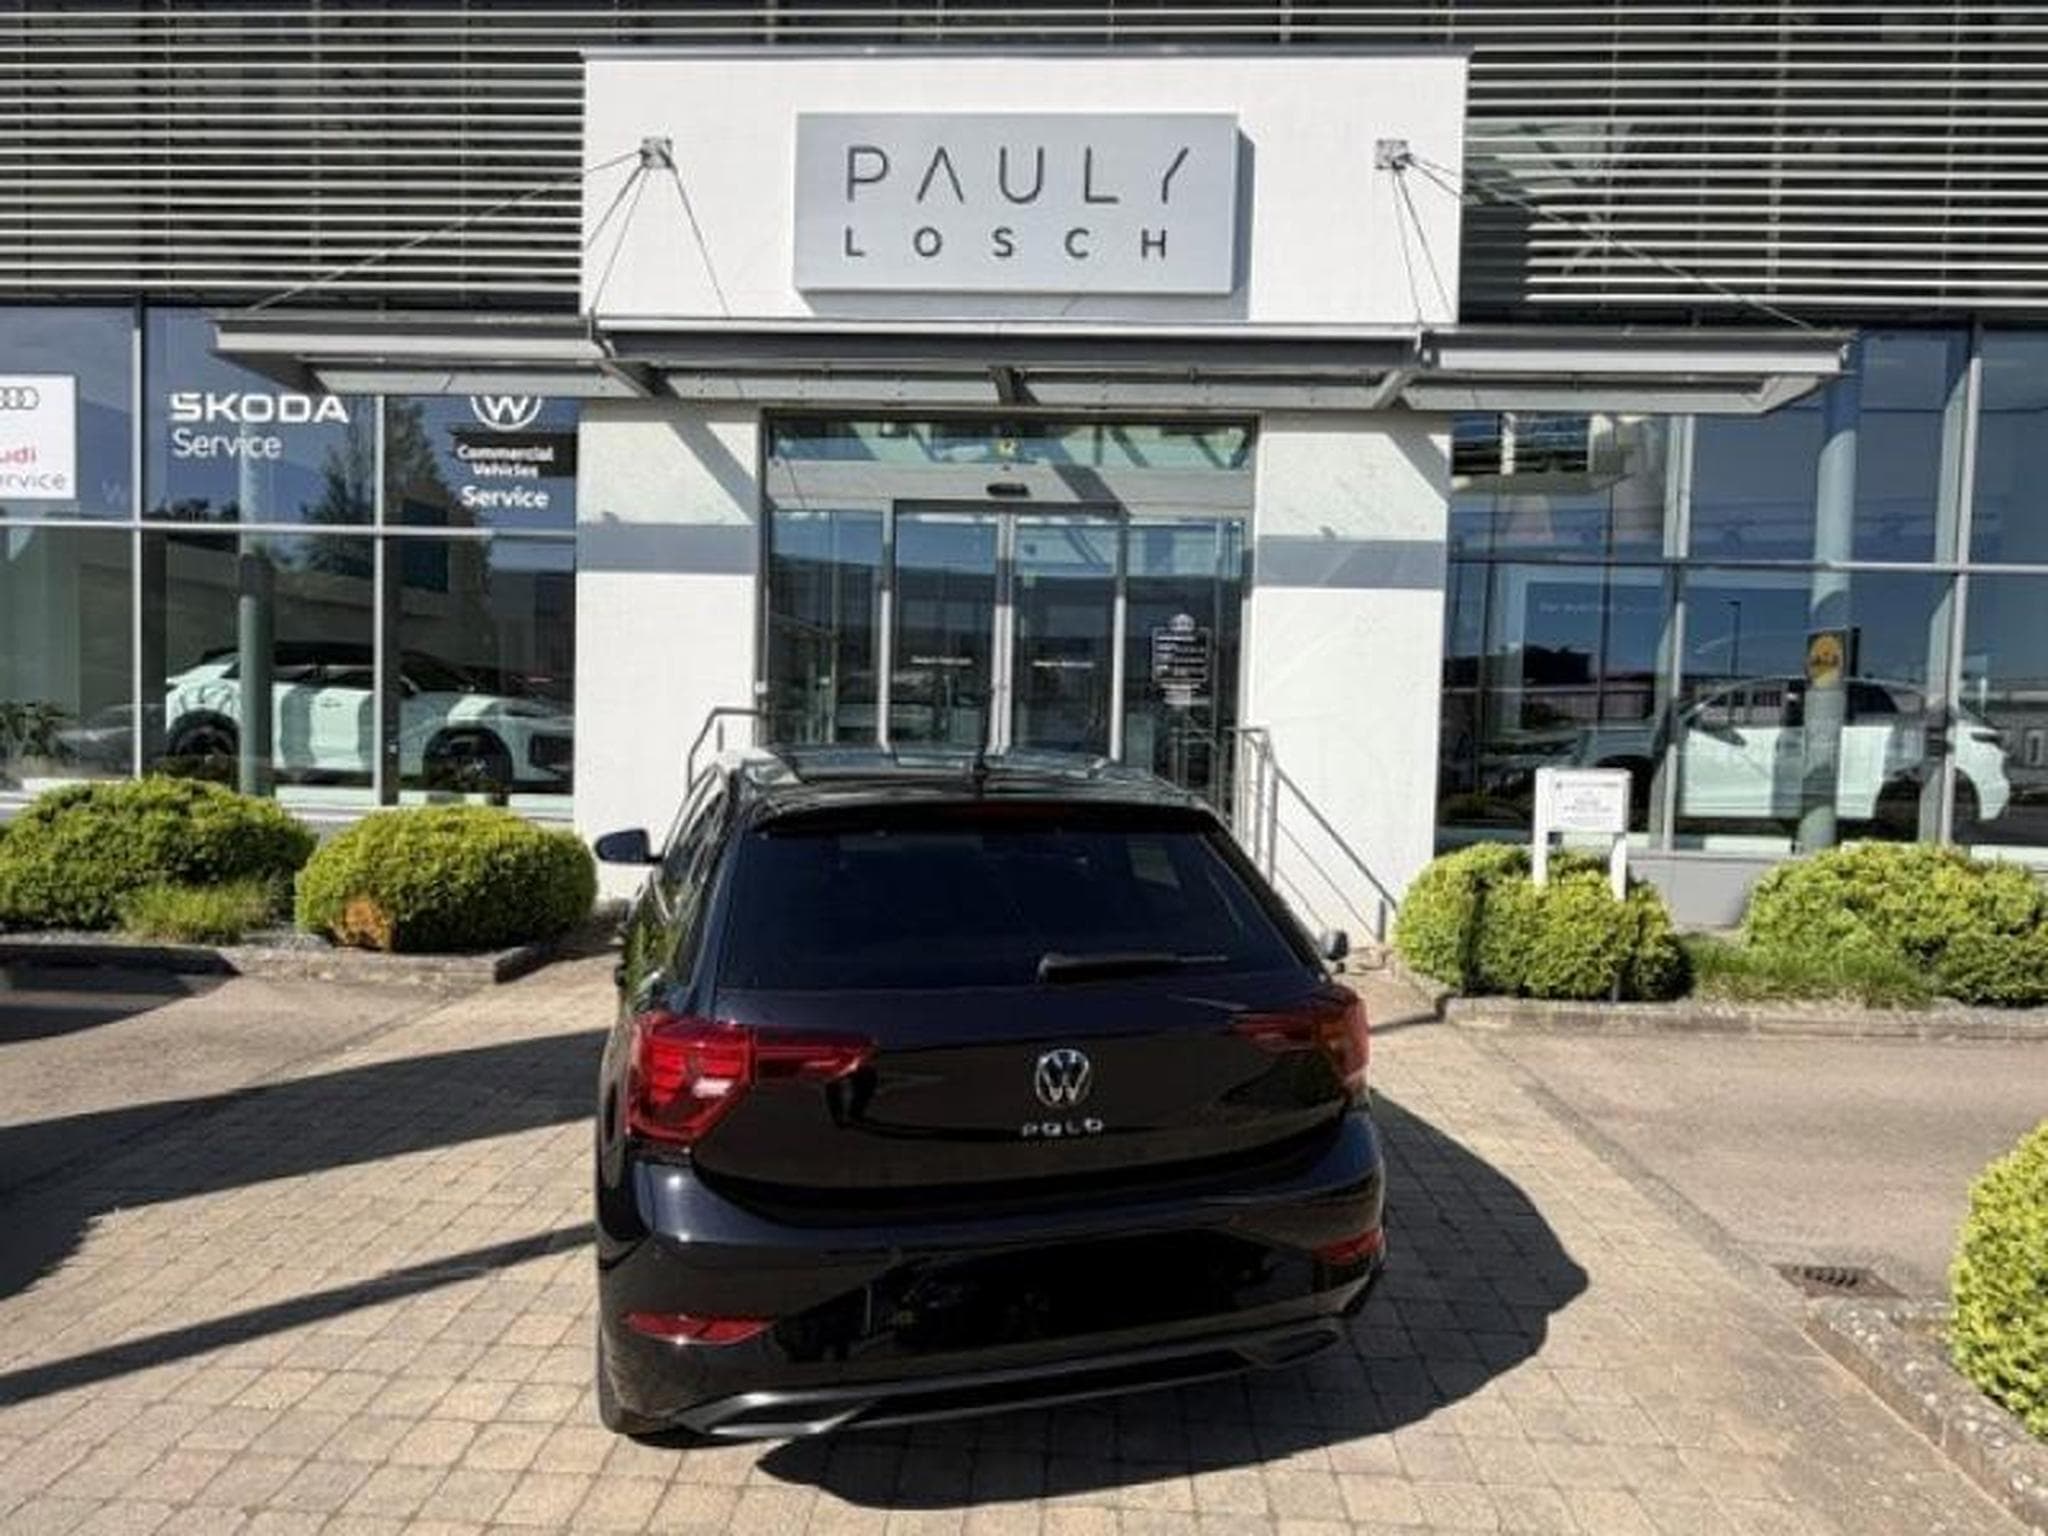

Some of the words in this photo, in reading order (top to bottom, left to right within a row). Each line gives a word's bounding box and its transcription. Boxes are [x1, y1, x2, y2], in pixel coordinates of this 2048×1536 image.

[846, 145, 1190, 204] PAULY
[844, 226, 1168, 259] LOSCH
[169, 391, 350, 424] SKODA
[172, 426, 284, 459] Service
[457, 444, 554, 462] Commercial
[0, 445, 37, 464] udi
[472, 462, 539, 478] Vehicles
[0, 472, 66, 491] rvice
[461, 485, 550, 508] Service
[1022, 1117, 1104, 1138] POLO
